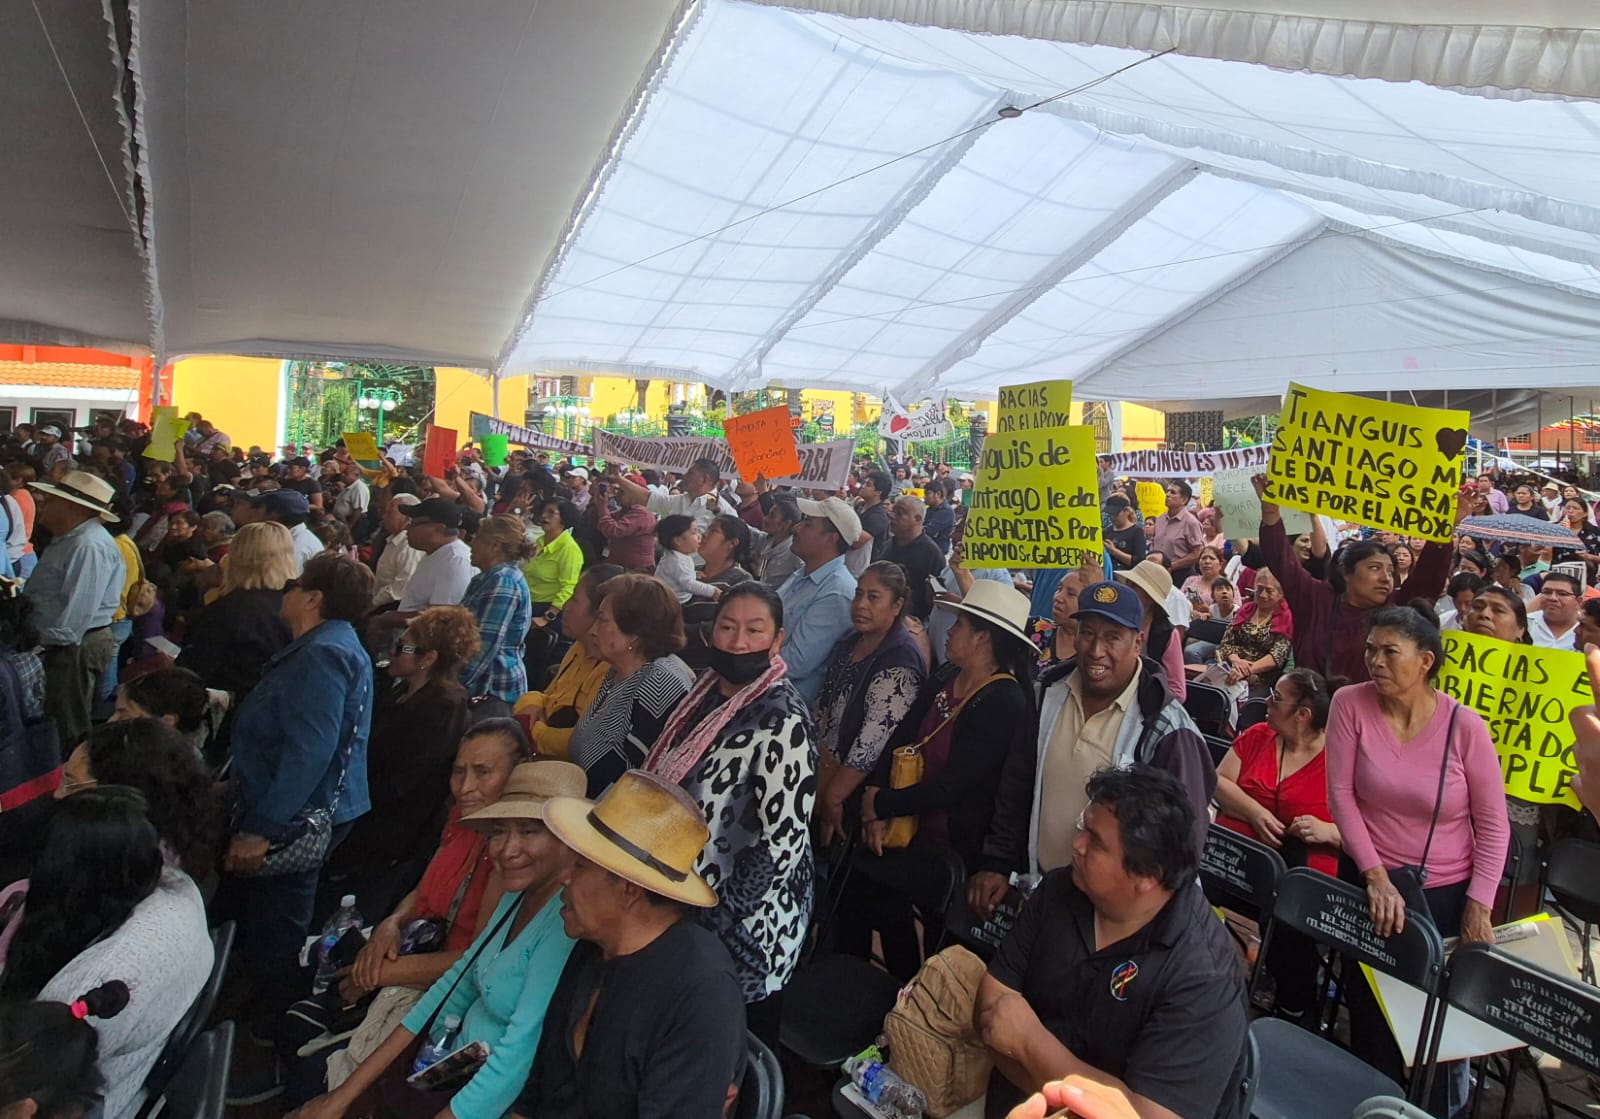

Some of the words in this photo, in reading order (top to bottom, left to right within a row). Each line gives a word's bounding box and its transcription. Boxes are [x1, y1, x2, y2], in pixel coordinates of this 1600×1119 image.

[1039, 438, 1071, 467] de
[1195, 453, 1216, 472] ES
[1273, 426, 1418, 480] SANTIAGO
[1271, 455, 1296, 478] LE
[1305, 462, 1336, 486] DA
[1345, 470, 1391, 499] LAS
[975, 515, 1064, 542] GRACIAS
[1316, 491, 1358, 515] POR
[1362, 500, 1385, 524] EL
[1390, 506, 1452, 538] APOYO
[971, 542, 1018, 561] APOYO
